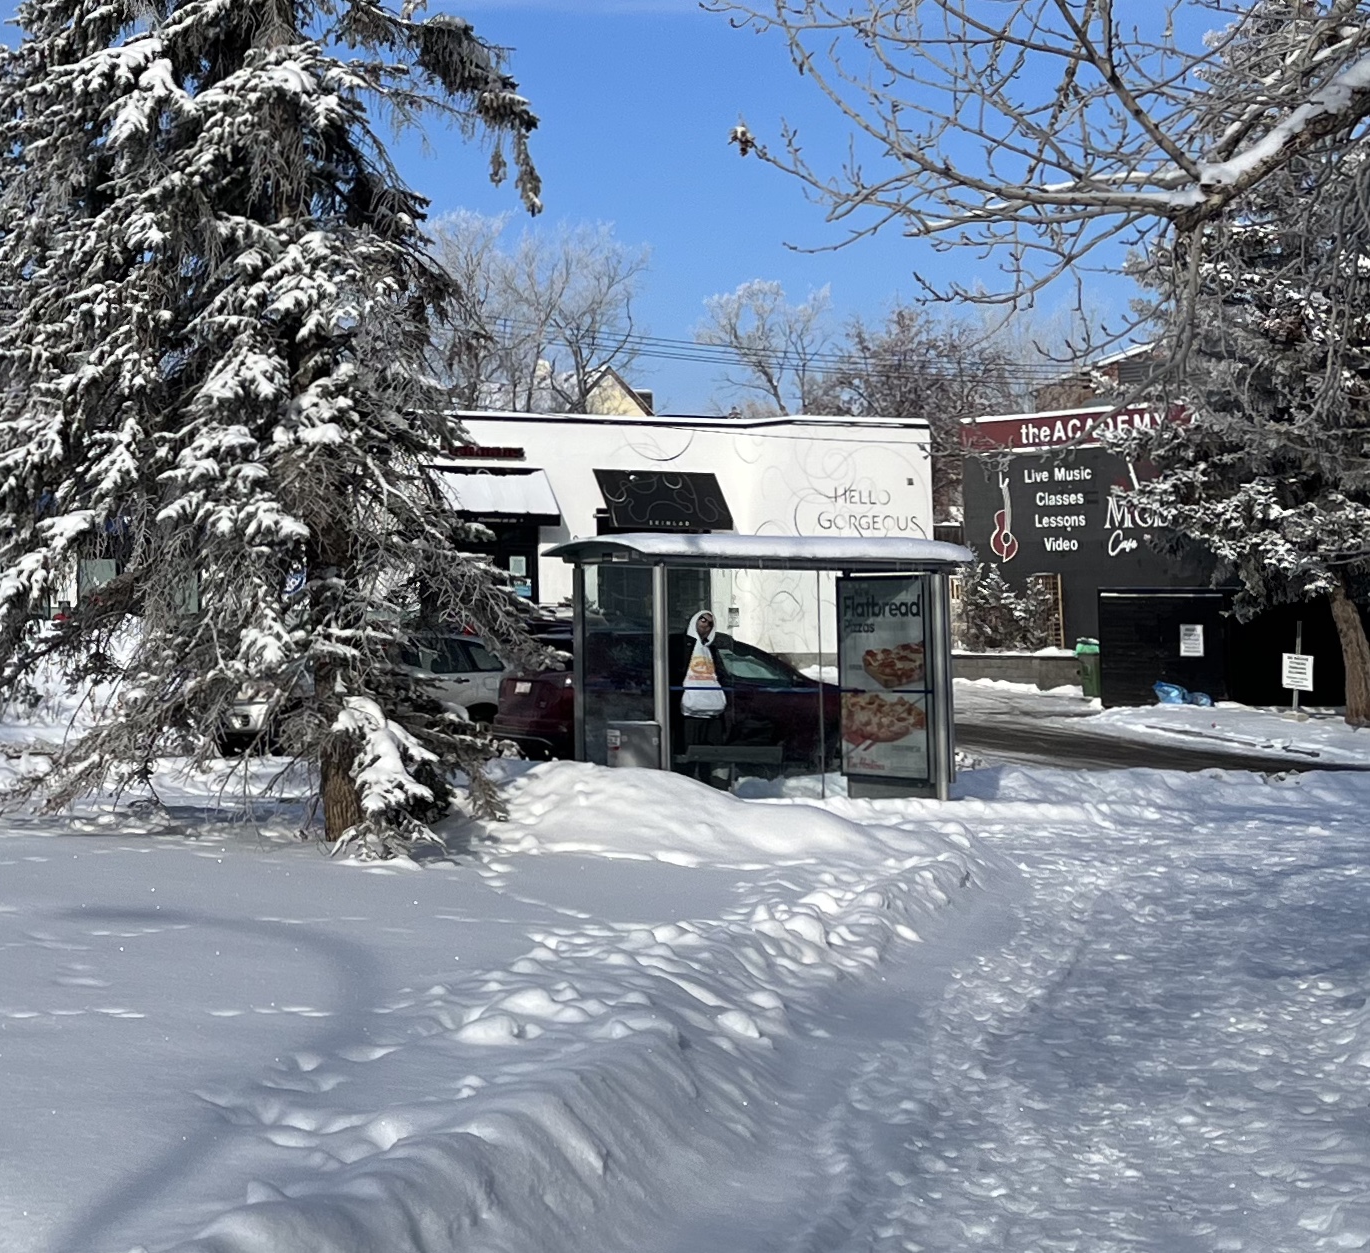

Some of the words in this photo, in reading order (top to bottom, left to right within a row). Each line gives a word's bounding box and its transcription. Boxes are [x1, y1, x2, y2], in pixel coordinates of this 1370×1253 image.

[1024, 469, 1050, 484] Live
[1054, 466, 1093, 482] Music
[833, 486, 891, 506] HELLO
[1035, 491, 1085, 507] Classes
[817, 510, 920, 536] GORGEOUS
[1034, 513, 1086, 528] Lessons
[1043, 536, 1079, 552] Video
[843, 593, 922, 618] Flatbread
[843, 618, 875, 634] Pizzas
